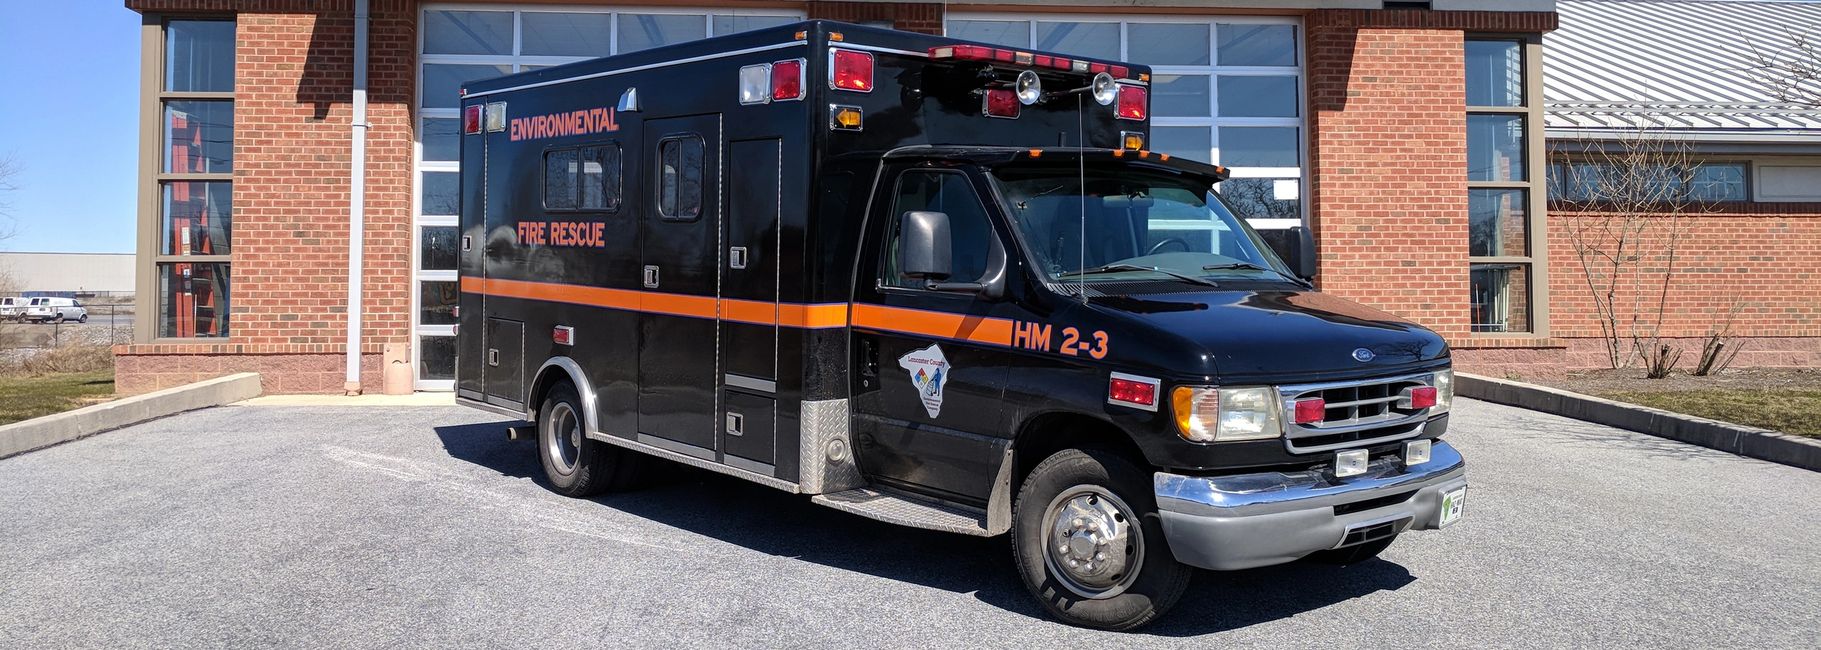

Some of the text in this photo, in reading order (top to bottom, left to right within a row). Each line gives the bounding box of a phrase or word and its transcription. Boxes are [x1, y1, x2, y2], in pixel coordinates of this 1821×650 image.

[511, 107, 619, 142] ENVIRONMENTAL
[518, 221, 605, 247] FIRE RESCUE
[1014, 320, 1108, 359] HM 2-3
